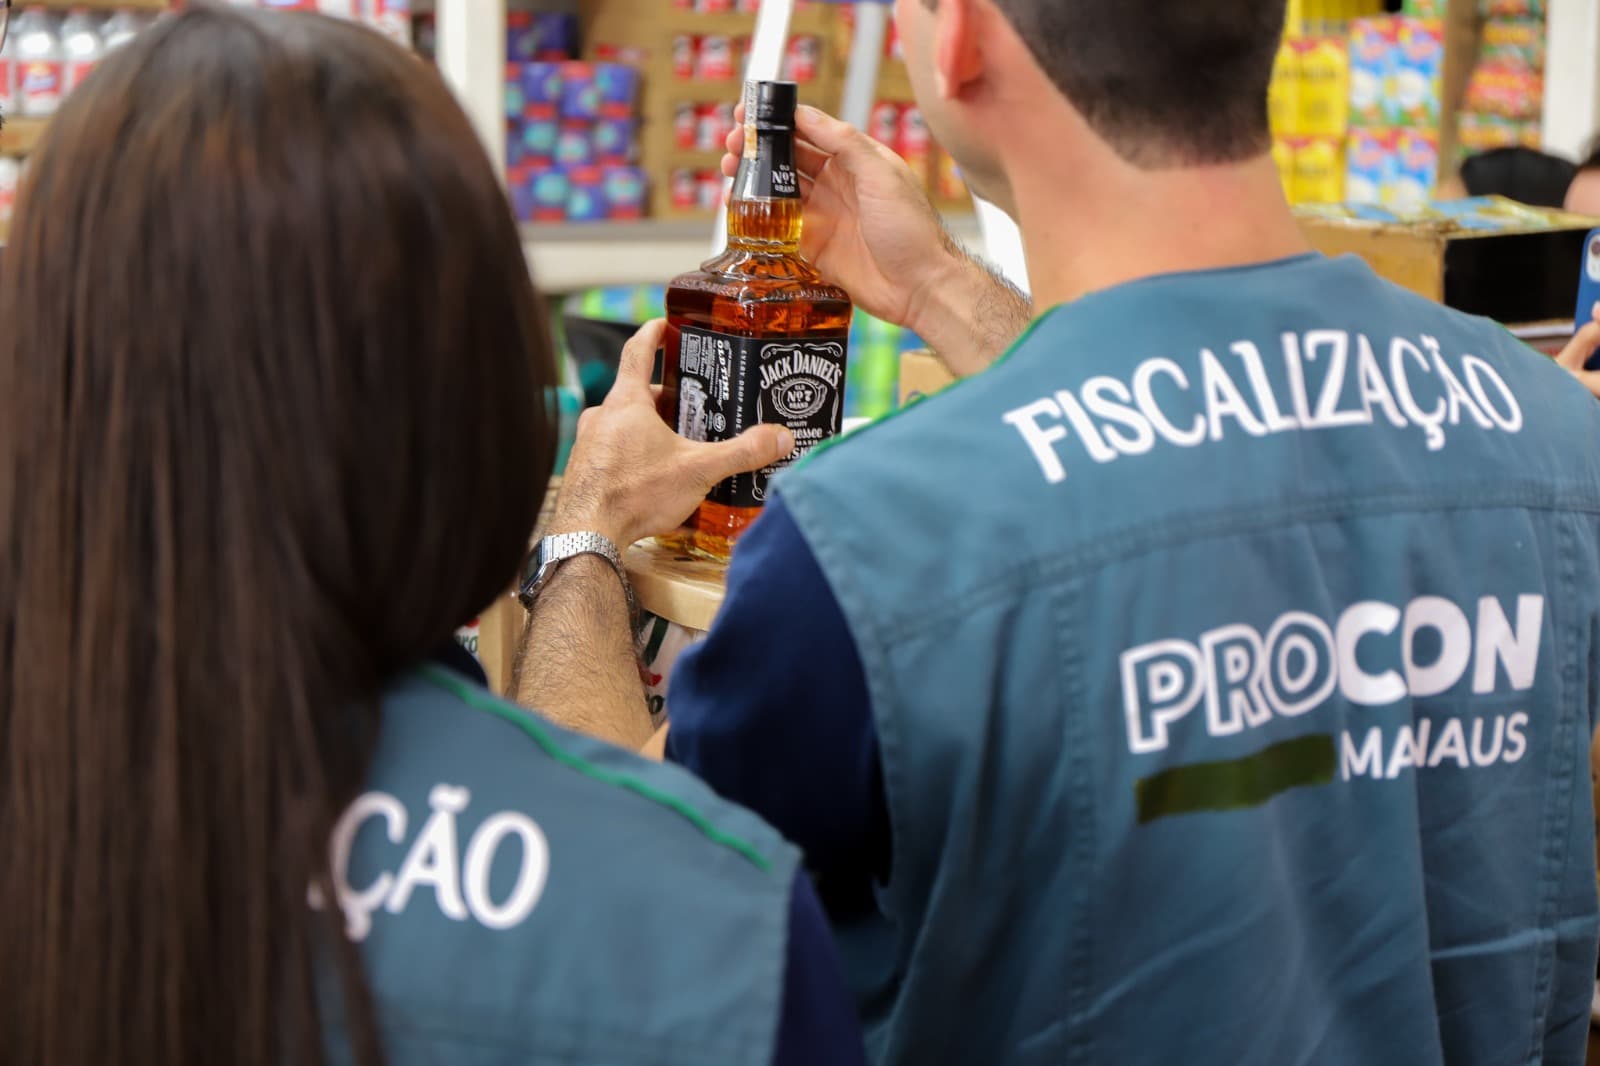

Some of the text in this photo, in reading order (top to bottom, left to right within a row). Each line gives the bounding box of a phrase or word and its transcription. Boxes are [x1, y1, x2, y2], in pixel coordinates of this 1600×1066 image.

[717, 340, 726, 365] OLD
[759, 356, 793, 390] JACK
[793, 350, 843, 390] DANIEL'S
[720, 366, 730, 401] TIME
[1003, 329, 1523, 484] FISCALIZAÇÃO
[790, 427, 823, 440] nessee
[1120, 594, 1544, 754] PROCON
[308, 783, 550, 942] ÇÃO
